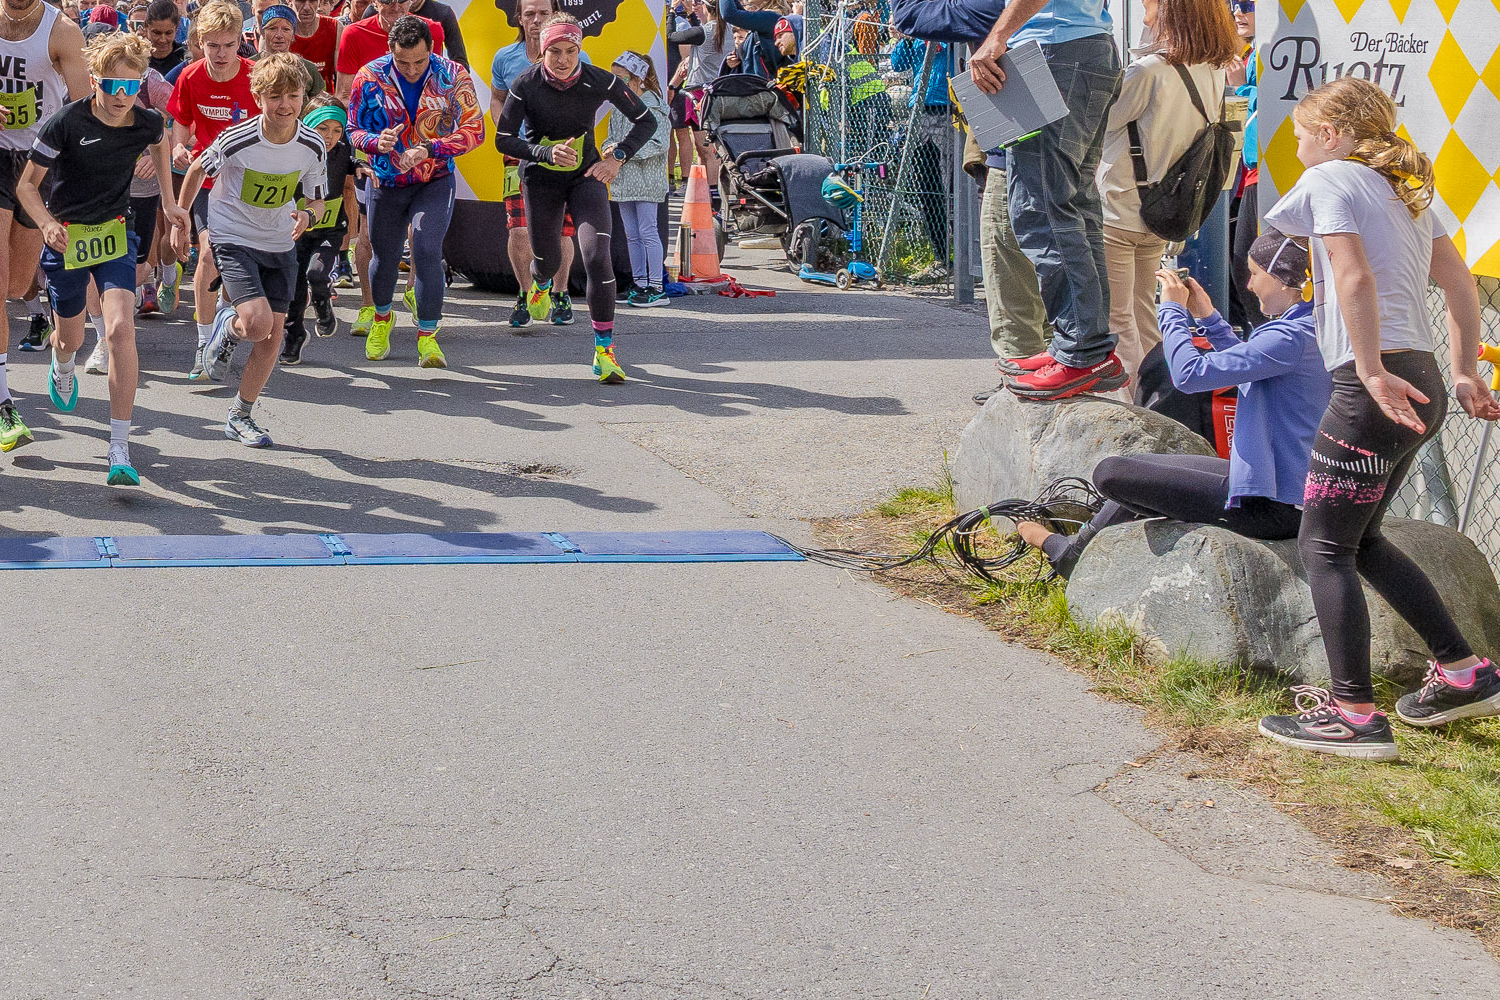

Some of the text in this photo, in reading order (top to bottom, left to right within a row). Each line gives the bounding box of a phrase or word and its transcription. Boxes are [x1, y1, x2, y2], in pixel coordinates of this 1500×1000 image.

[1350, 31, 1429, 54] Der Bäcker
[252, 183, 288, 205] 721
[75, 234, 117, 263] 800
